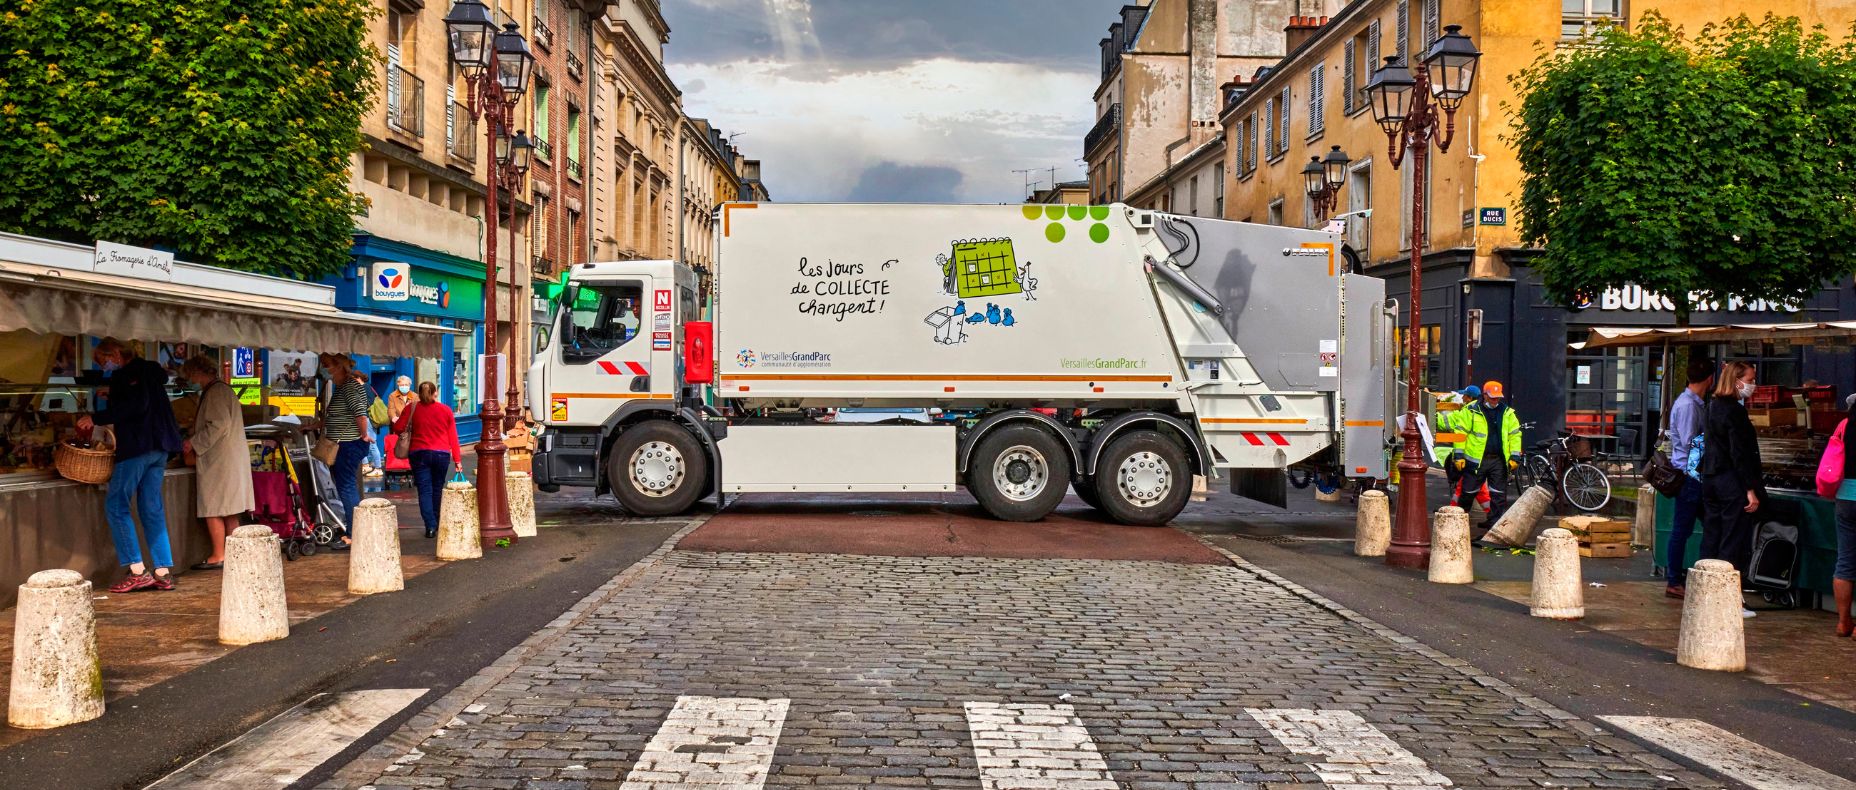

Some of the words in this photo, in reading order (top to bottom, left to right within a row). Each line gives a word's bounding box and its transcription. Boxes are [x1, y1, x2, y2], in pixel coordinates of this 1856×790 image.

[96, 251, 107, 265] La
[110, 250, 145, 269] Fromagerie
[798, 257, 823, 277] les
[826, 258, 864, 278] jours
[375, 289, 405, 298] bouygues
[790, 281, 810, 295] de
[814, 279, 890, 296] COLLECTE
[657, 291, 669, 305] N
[760, 351, 832, 361] VersaillesGrandParc
